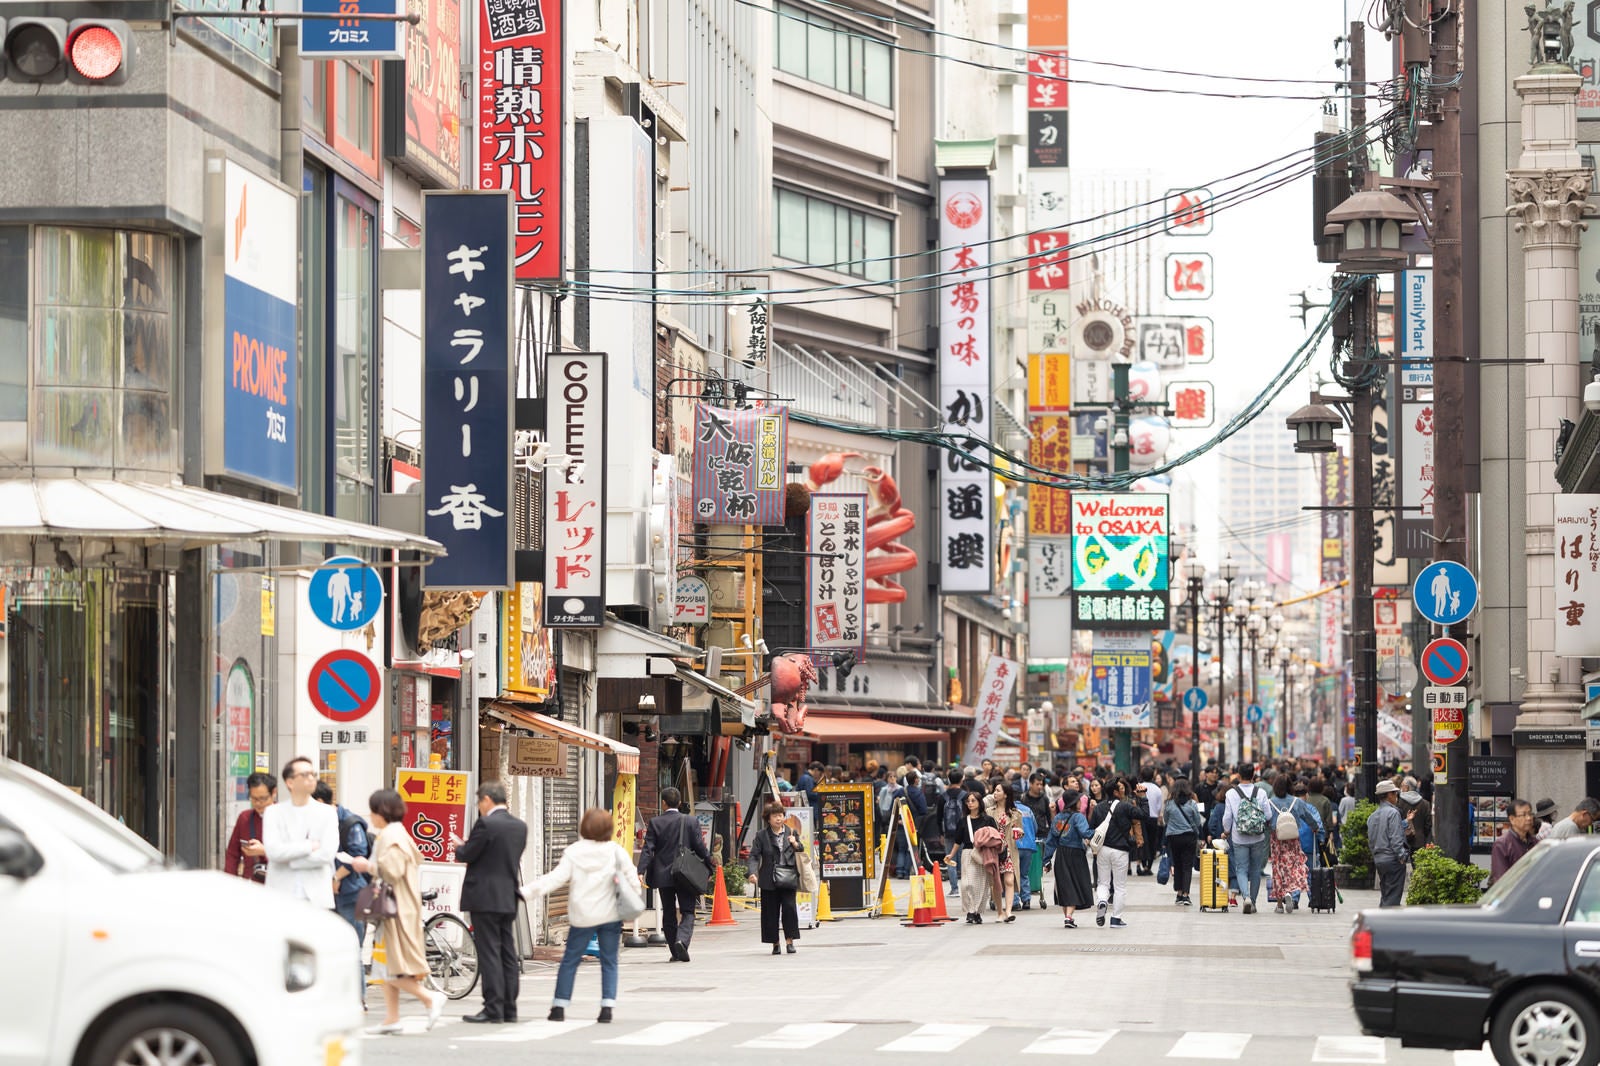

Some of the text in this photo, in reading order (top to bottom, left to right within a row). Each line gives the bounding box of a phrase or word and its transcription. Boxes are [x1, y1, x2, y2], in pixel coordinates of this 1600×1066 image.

[328, 29, 369, 43] プロミス
[492, 13, 541, 36] 酒場
[482, 49, 493, 145] JONETSU
[950, 242, 980, 368] 本場の味
[1412, 274, 1426, 351] FamilyMart
[232, 330, 287, 405] PROMISE
[266, 406, 287, 443] プロミス
[699, 411, 759, 518] 大阪に乾杯
[761, 419, 777, 486] 日本酒バル
[946, 389, 985, 570] かに道楽
[699, 502, 714, 513] 2F
[1076, 499, 1164, 517] Welcome
[554, 490, 597, 590] レッド
[1076, 520, 1164, 535] to OSAKA
[843, 503, 861, 641] 温泉水しゃぶしゃぶ
[1557, 534, 1585, 627] はり重
[675, 604, 705, 616] アーゴ
[1078, 595, 1165, 620] 道頓堀商店会
[972, 662, 1010, 756] 春の新作会席
[1426, 692, 1465, 704] 自動車
[320, 730, 367, 744] 自動車
[430, 775, 441, 801] 当ビル
[446, 776, 463, 788] 4F
[446, 789, 462, 802] 5F
[428, 885, 452, 894] café
[426, 900, 452, 912] Bon
